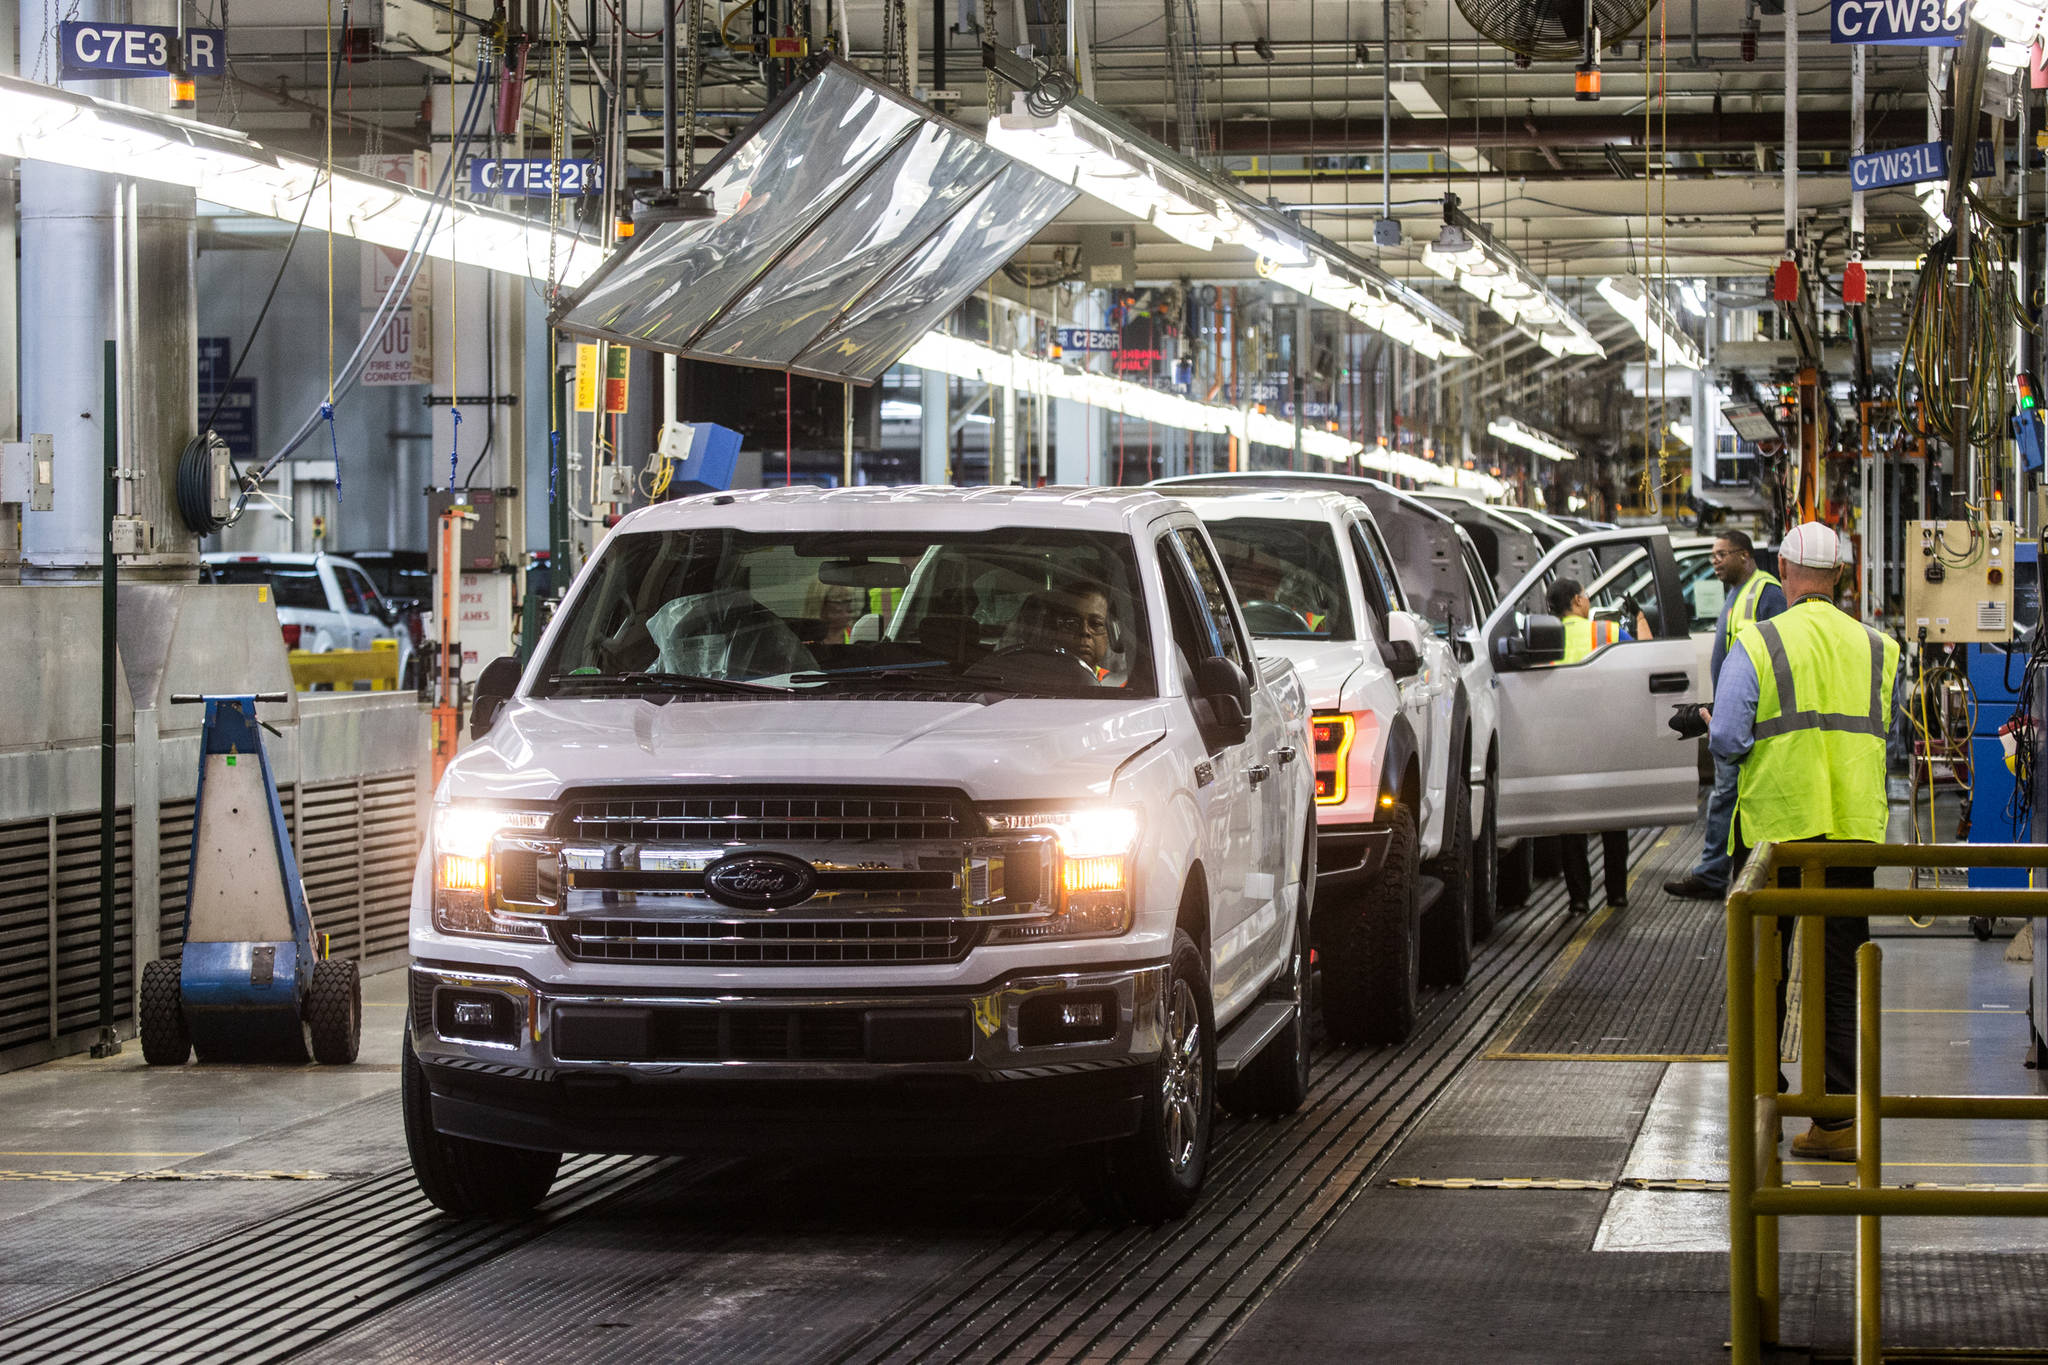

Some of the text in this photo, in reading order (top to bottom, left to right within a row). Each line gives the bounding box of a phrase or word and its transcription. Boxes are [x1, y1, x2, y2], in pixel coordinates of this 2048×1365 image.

[75, 27, 215, 68] C7E3R
[1853, 147, 1939, 186] C7W31L
[370, 361, 411, 370] FIRE HO
[364, 372, 412, 382] CONNECT
[735, 869, 784, 889] Ford
